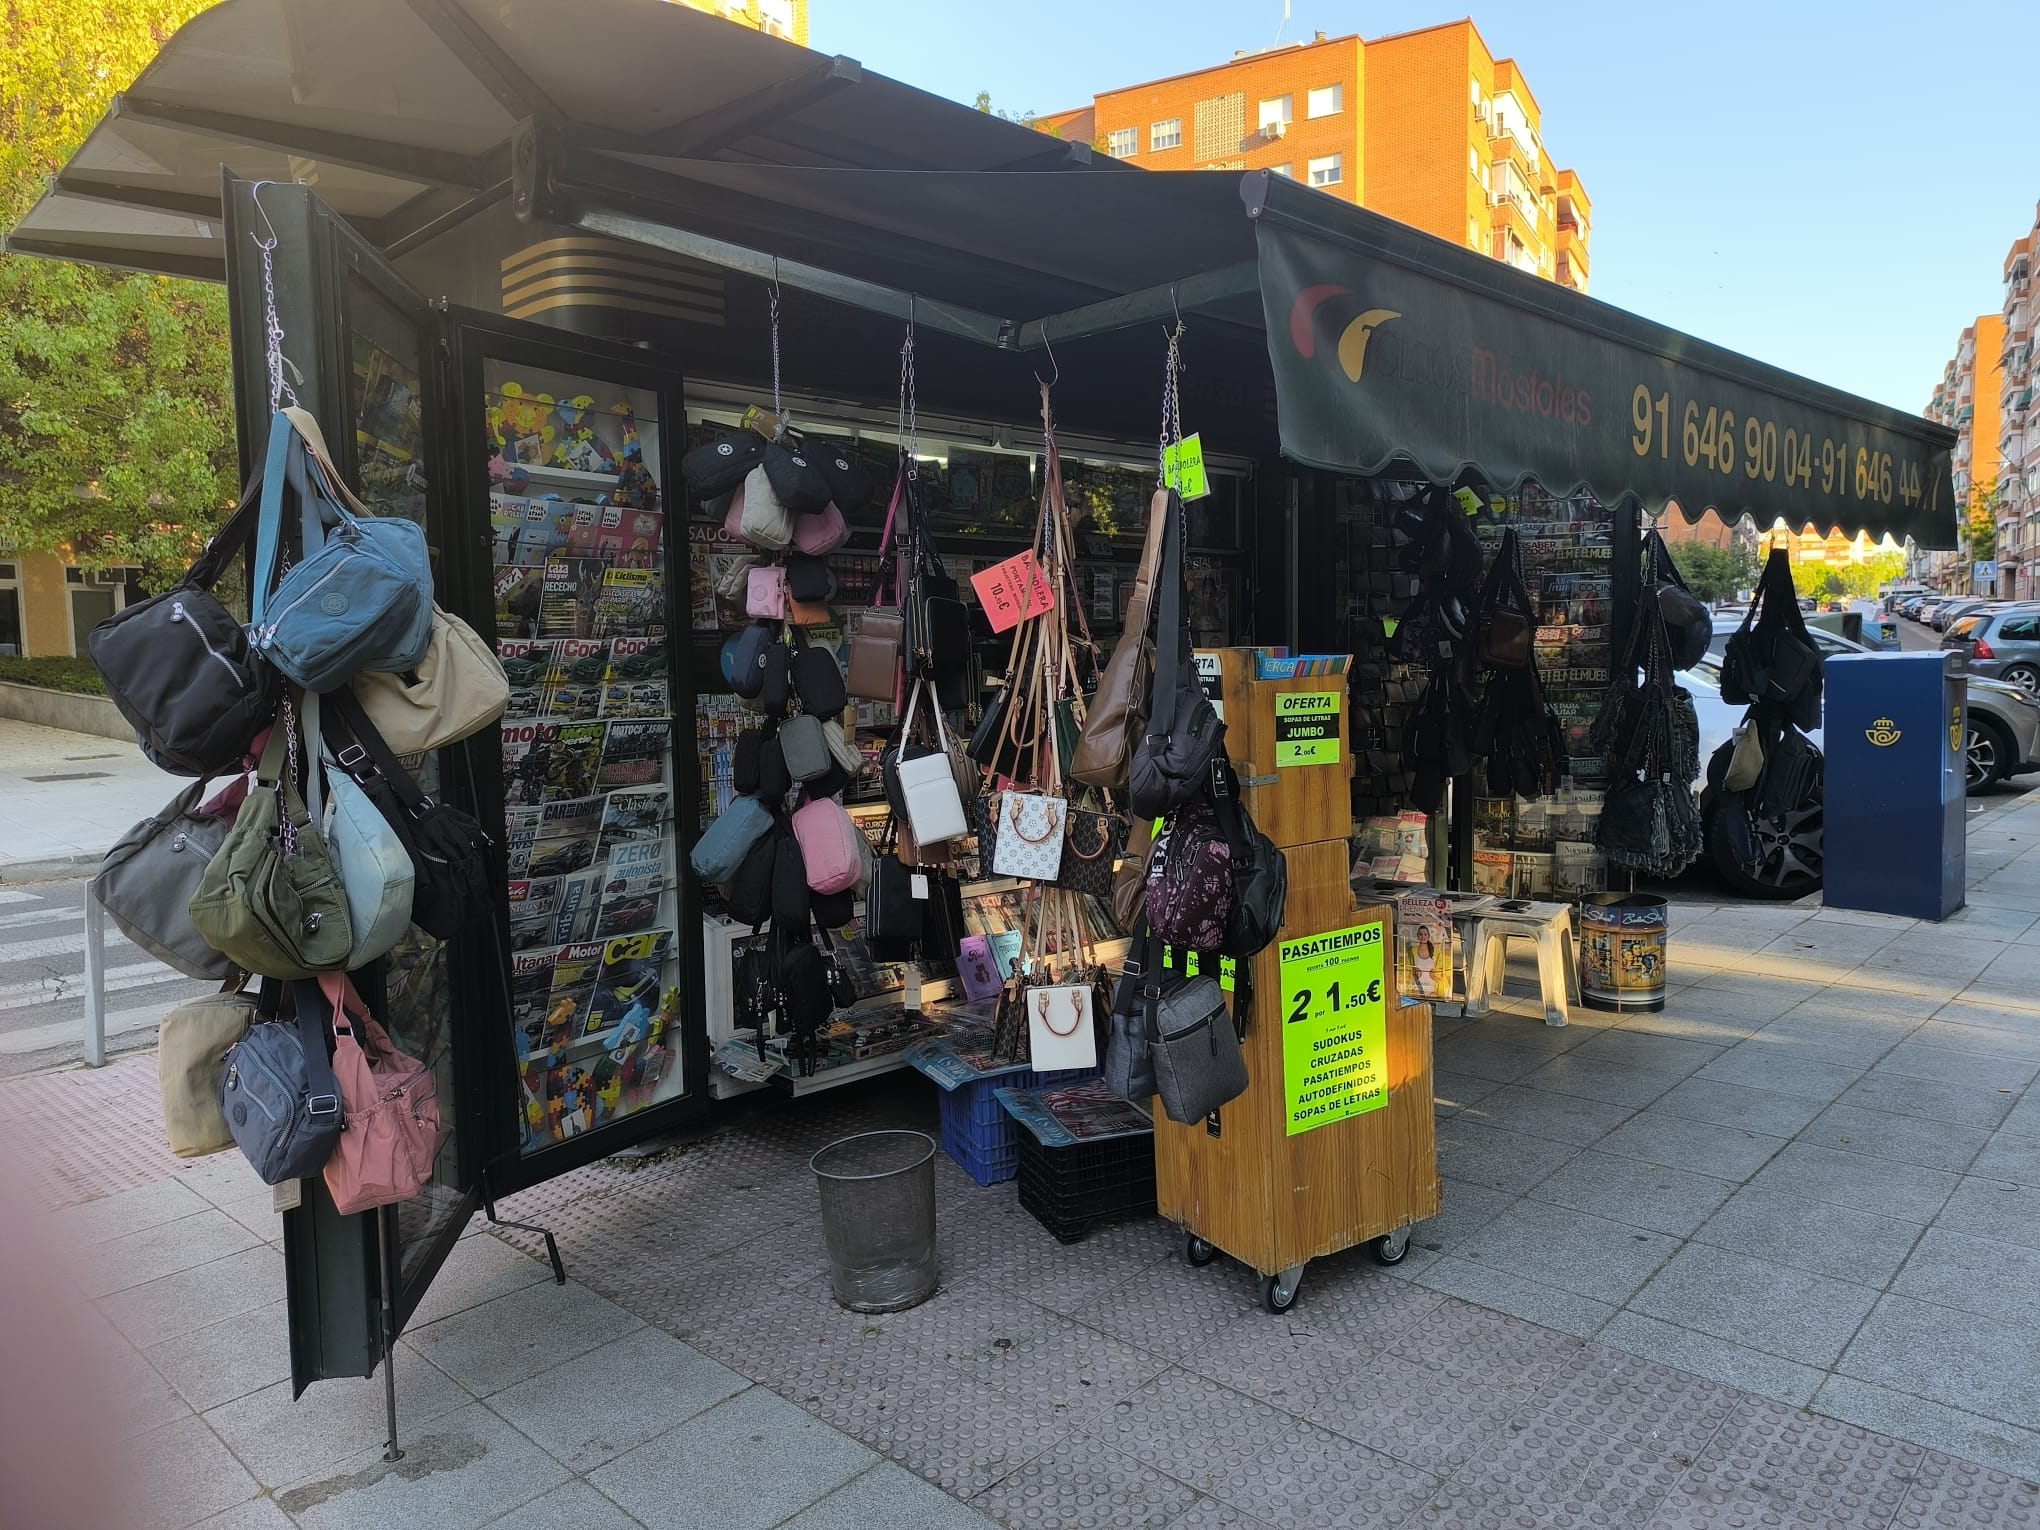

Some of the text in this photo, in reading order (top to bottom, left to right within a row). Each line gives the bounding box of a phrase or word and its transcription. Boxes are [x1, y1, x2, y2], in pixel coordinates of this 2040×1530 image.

[1632, 384, 1670, 458] 91
[1683, 399, 1735, 475] 646
[1744, 417, 1777, 482] 90
[1855, 446, 1893, 505] 646
[1168, 456, 1201, 474] BADOLERA
[688, 526, 737, 542] SADO
[1021, 555, 1049, 609] BADOLERA
[1283, 696, 1331, 709] OFERTA
[1287, 726, 1324, 738] JUMBO
[544, 804, 566, 820] CAR
[614, 862, 661, 879] autopista
[568, 945, 603, 959] Motor
[1282, 928, 1381, 960] PASATIEMPOS
[1324, 957, 1340, 967] 100
[1288, 989, 1312, 1024] 2
[1314, 1010, 1325, 1018] por
[1313, 1030, 1362, 1052] SUDOKUS
[1310, 1046, 1363, 1068] CRUZADAS
[1304, 1060, 1371, 1086] PASATIEMPOS
[1299, 1074, 1376, 1104] AUTODEFINIDOS
[1293, 1104, 1326, 1121] SOPAS
[1329, 1099, 1341, 1110] DE
[1344, 1088, 1380, 1106] LETRAS
